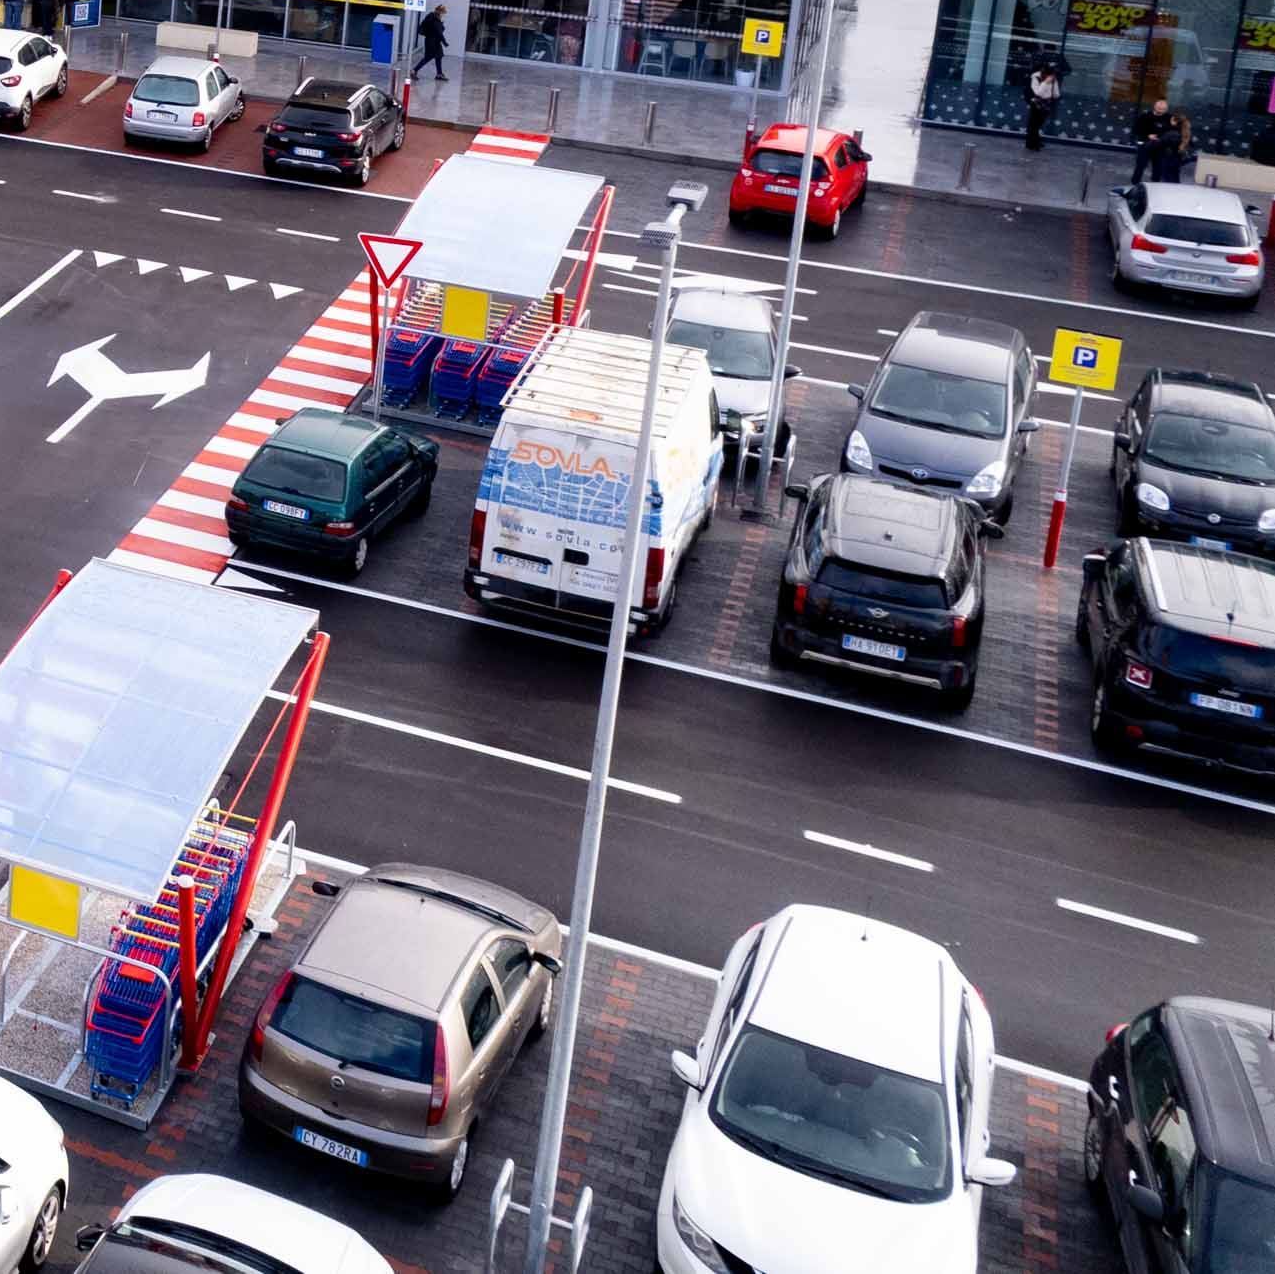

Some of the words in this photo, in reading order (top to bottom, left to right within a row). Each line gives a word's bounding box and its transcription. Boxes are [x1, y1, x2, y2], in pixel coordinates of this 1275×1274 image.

[1076, 347, 1095, 365] P
[509, 439, 619, 480] SOVLA
[303, 1131, 318, 1146] CY
[321, 1138, 359, 1163] 782RA
